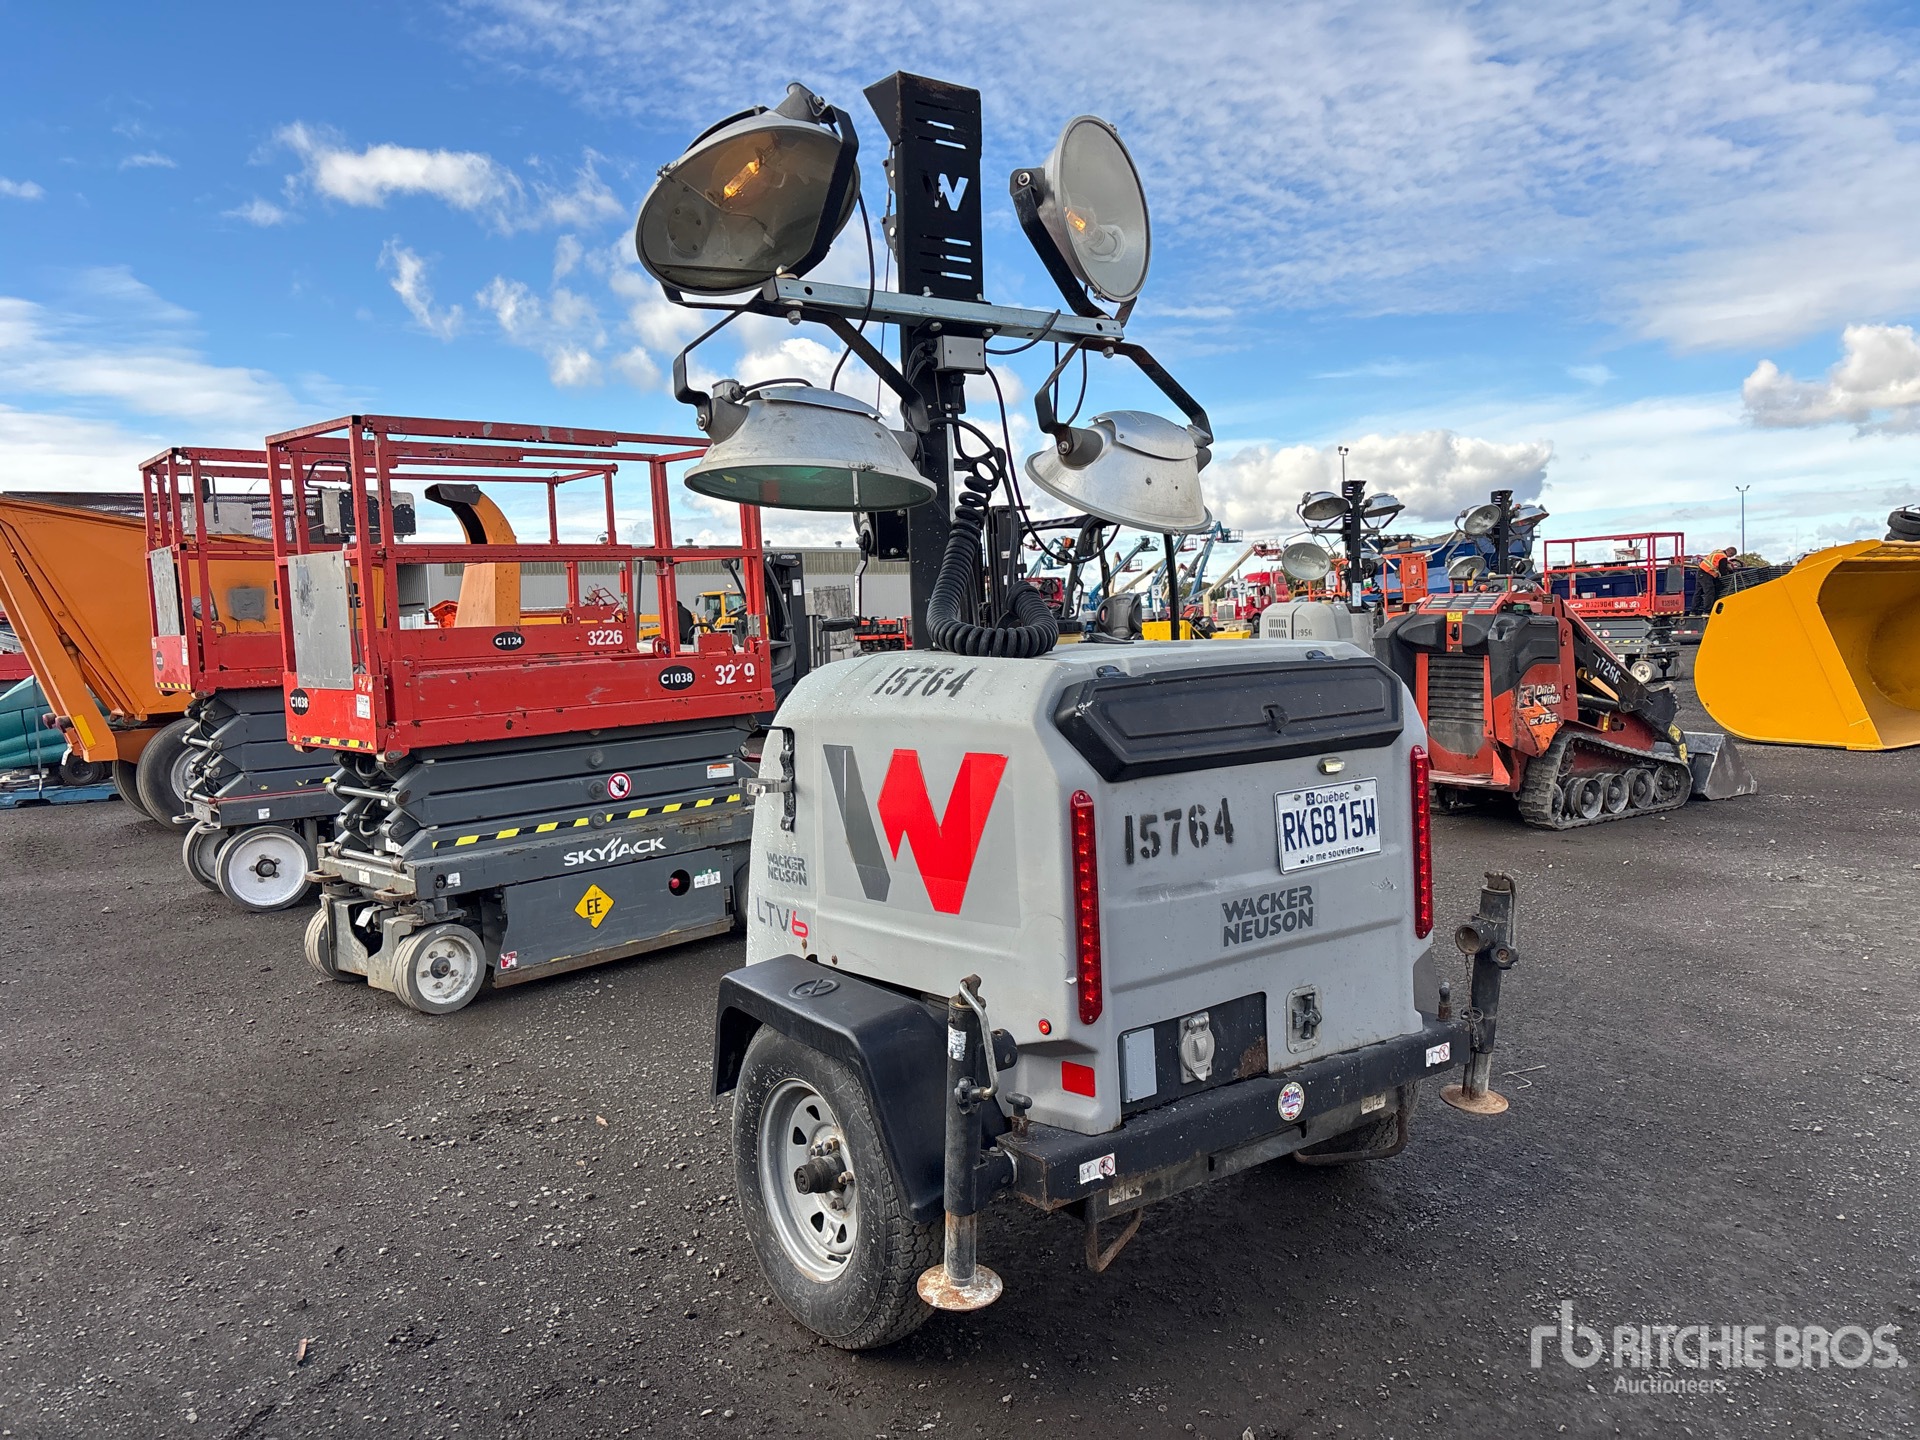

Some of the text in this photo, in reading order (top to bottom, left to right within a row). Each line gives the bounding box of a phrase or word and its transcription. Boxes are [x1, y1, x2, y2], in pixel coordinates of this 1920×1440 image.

[1154, 588, 1160, 596] 3
[495, 636, 522, 646] C1124
[587, 630, 623, 646] 3226
[661, 672, 693, 684] C1038
[873, 666, 977, 697] 15764
[1536, 684, 1556, 695] Ditch
[290, 695, 309, 709] C1038
[1541, 694, 1561, 706] Witch
[1316, 790, 1350, 805] Québec
[1125, 797, 1234, 865] 15764
[1282, 798, 1376, 852] RK6815W
[564, 837, 666, 866] SKYJACK
[766, 850, 806, 872] WACKER
[1306, 845, 1360, 863] Je me souviens
[767, 865, 808, 886] NEUSON
[586, 897, 602, 916] EE
[1222, 885, 1314, 923] WACKER
[757, 896, 809, 938] LTV6
[1223, 906, 1314, 947] NEUSON
